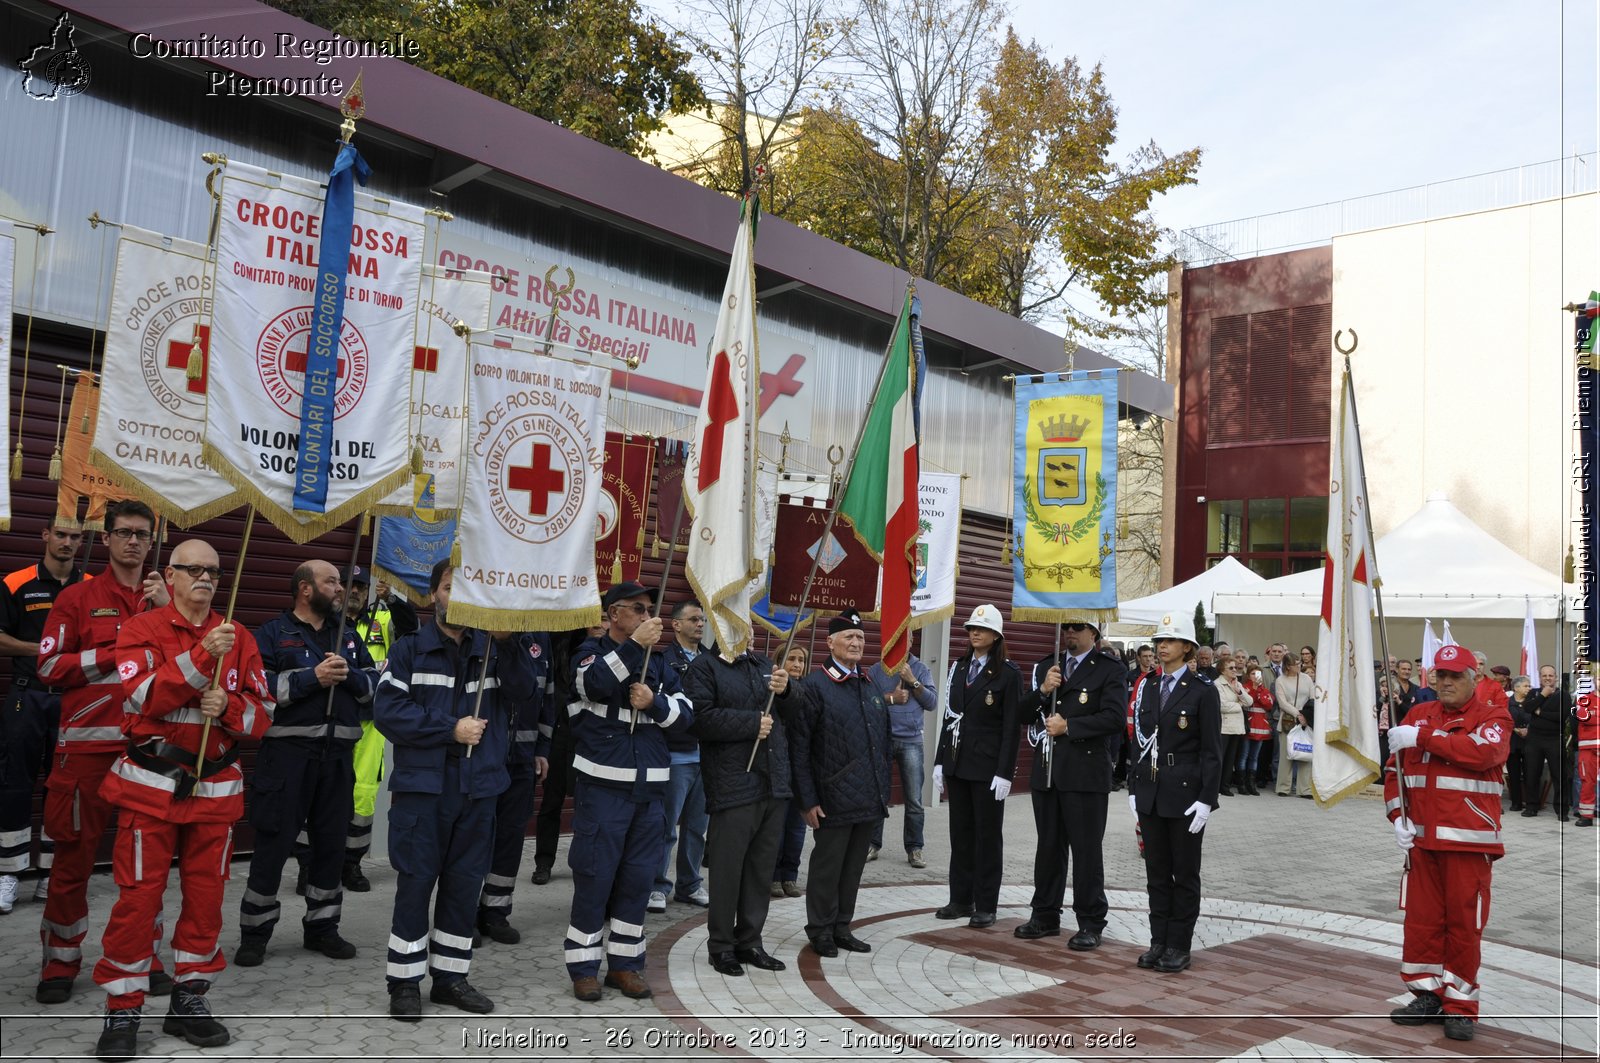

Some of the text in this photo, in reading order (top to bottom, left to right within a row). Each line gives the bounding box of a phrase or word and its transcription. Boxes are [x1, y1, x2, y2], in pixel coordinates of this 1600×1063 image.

[237, 198, 408, 259] CROCE OSSA
[266, 235, 379, 280] ITALNA
[126, 274, 212, 332] CROCE ROS
[234, 261, 285, 286] COMITATO
[359, 287, 369, 303] DI
[373, 291, 403, 311] TORINO
[162, 308, 178, 322] DI
[179, 300, 212, 315] GINE
[281, 315, 297, 333] DI
[527, 275, 601, 320] ROSSA
[607, 298, 697, 347] ITALIANA
[343, 332, 359, 347] 22
[576, 325, 651, 364] Speciali
[260, 327, 293, 405] CONVENZIONE
[301, 272, 340, 495] VOLONTARI DEL SOCCORSO
[350, 349, 366, 393] AGOSTO
[474, 363, 502, 379] CORPO
[506, 369, 550, 387] VOLONTARI
[506, 390, 557, 411] ROSSA
[349, 440, 376, 459] DEL
[488, 418, 583, 538] CONVENZIONE DI GINEVRA 22 AGOSTO 1864
[614, 478, 642, 520] PIEMONTE
[629, 554, 638, 562] DI
[464, 566, 567, 590] CASTAGNOLE
[803, 575, 846, 588] SEZIONE
[790, 594, 856, 607] NICHELINO
